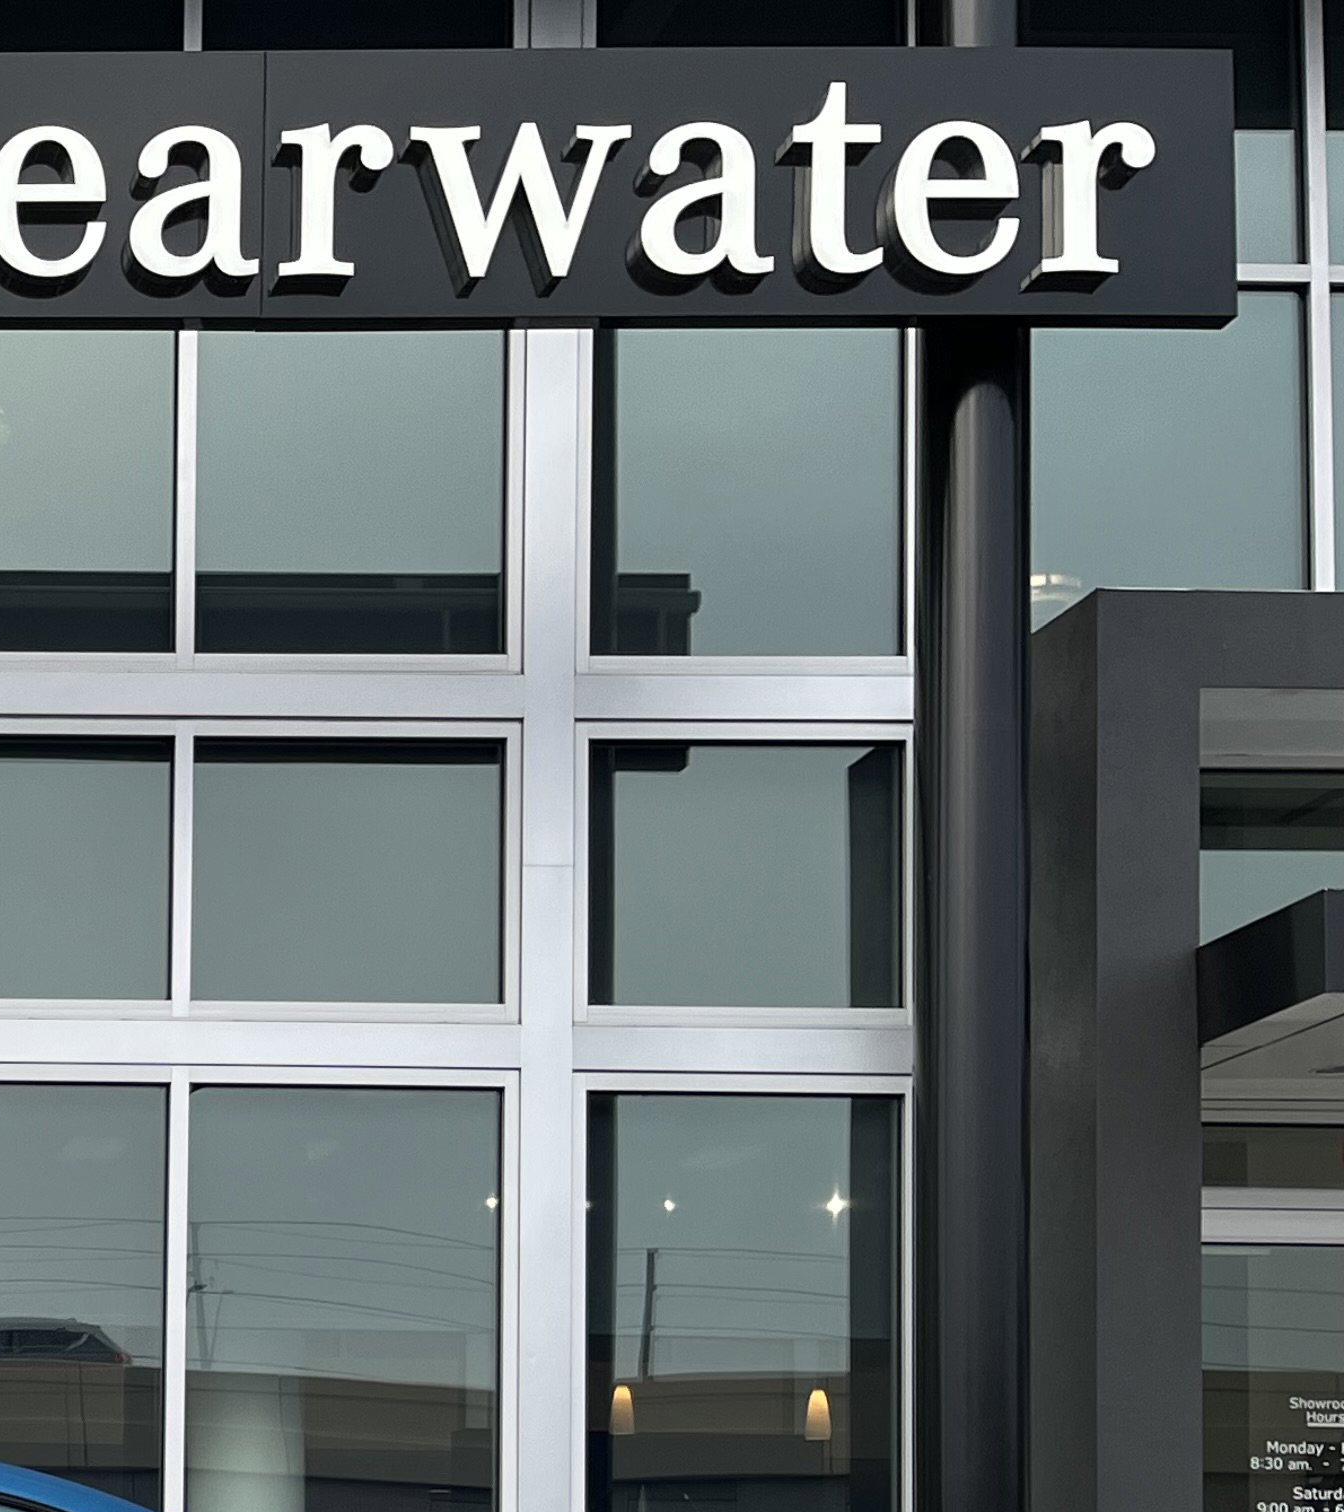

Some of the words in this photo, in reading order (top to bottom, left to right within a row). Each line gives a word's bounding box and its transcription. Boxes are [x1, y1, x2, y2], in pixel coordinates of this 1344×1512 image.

[1266, 1440, 1324, 1457] Monday
[1250, 1456, 1283, 1470] 8:30
[1292, 1486, 1344, 1500] Saturd
